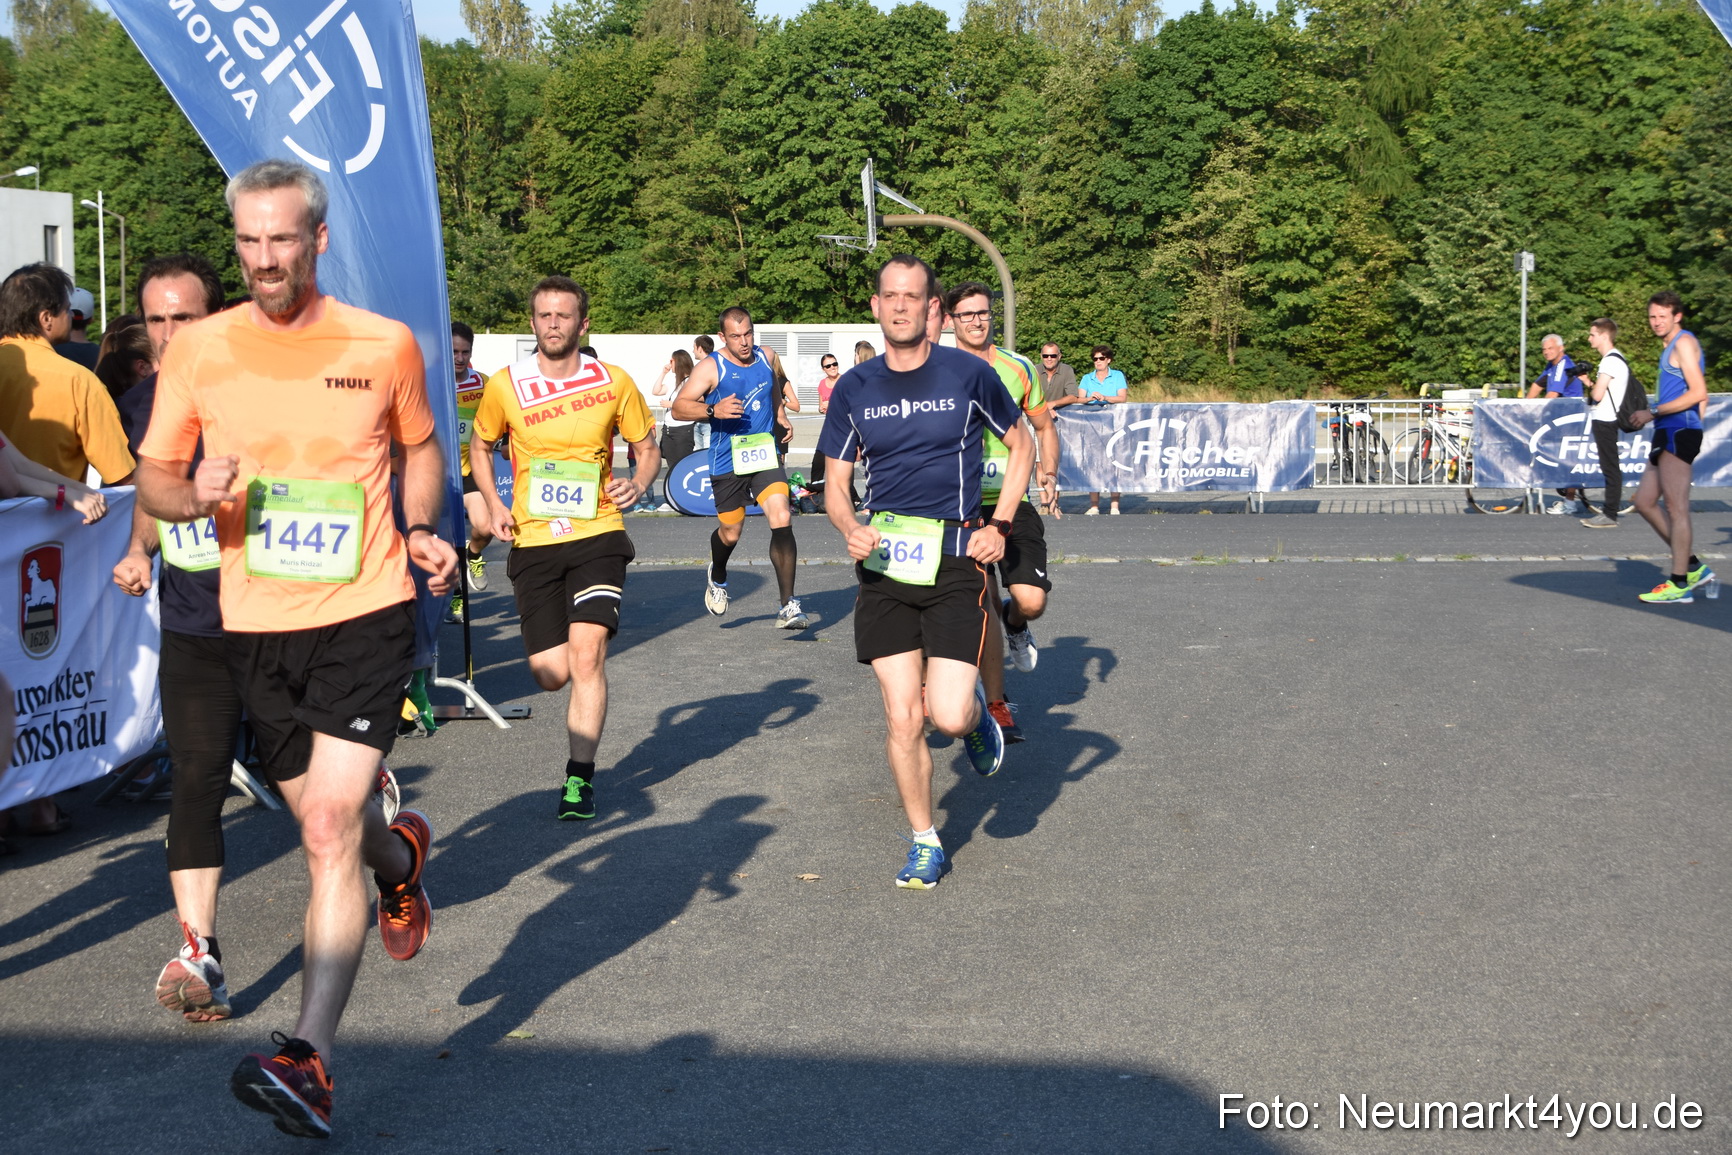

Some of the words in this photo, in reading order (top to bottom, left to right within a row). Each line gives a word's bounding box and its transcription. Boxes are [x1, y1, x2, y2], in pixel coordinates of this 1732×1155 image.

[325, 378, 373, 390] THULE
[523, 404, 567, 428] MAX
[571, 389, 617, 413] BÖGL
[864, 404, 899, 420] EURO
[912, 398, 956, 413] POLES
[741, 448, 767, 463] 850
[1134, 440, 1261, 465] Fischer
[1145, 467, 1251, 479] AUTOMOBILE
[541, 483, 583, 505] 864
[257, 518, 350, 555] 1447
[879, 538, 924, 565] 364
[29, 630, 50, 648] 1628
